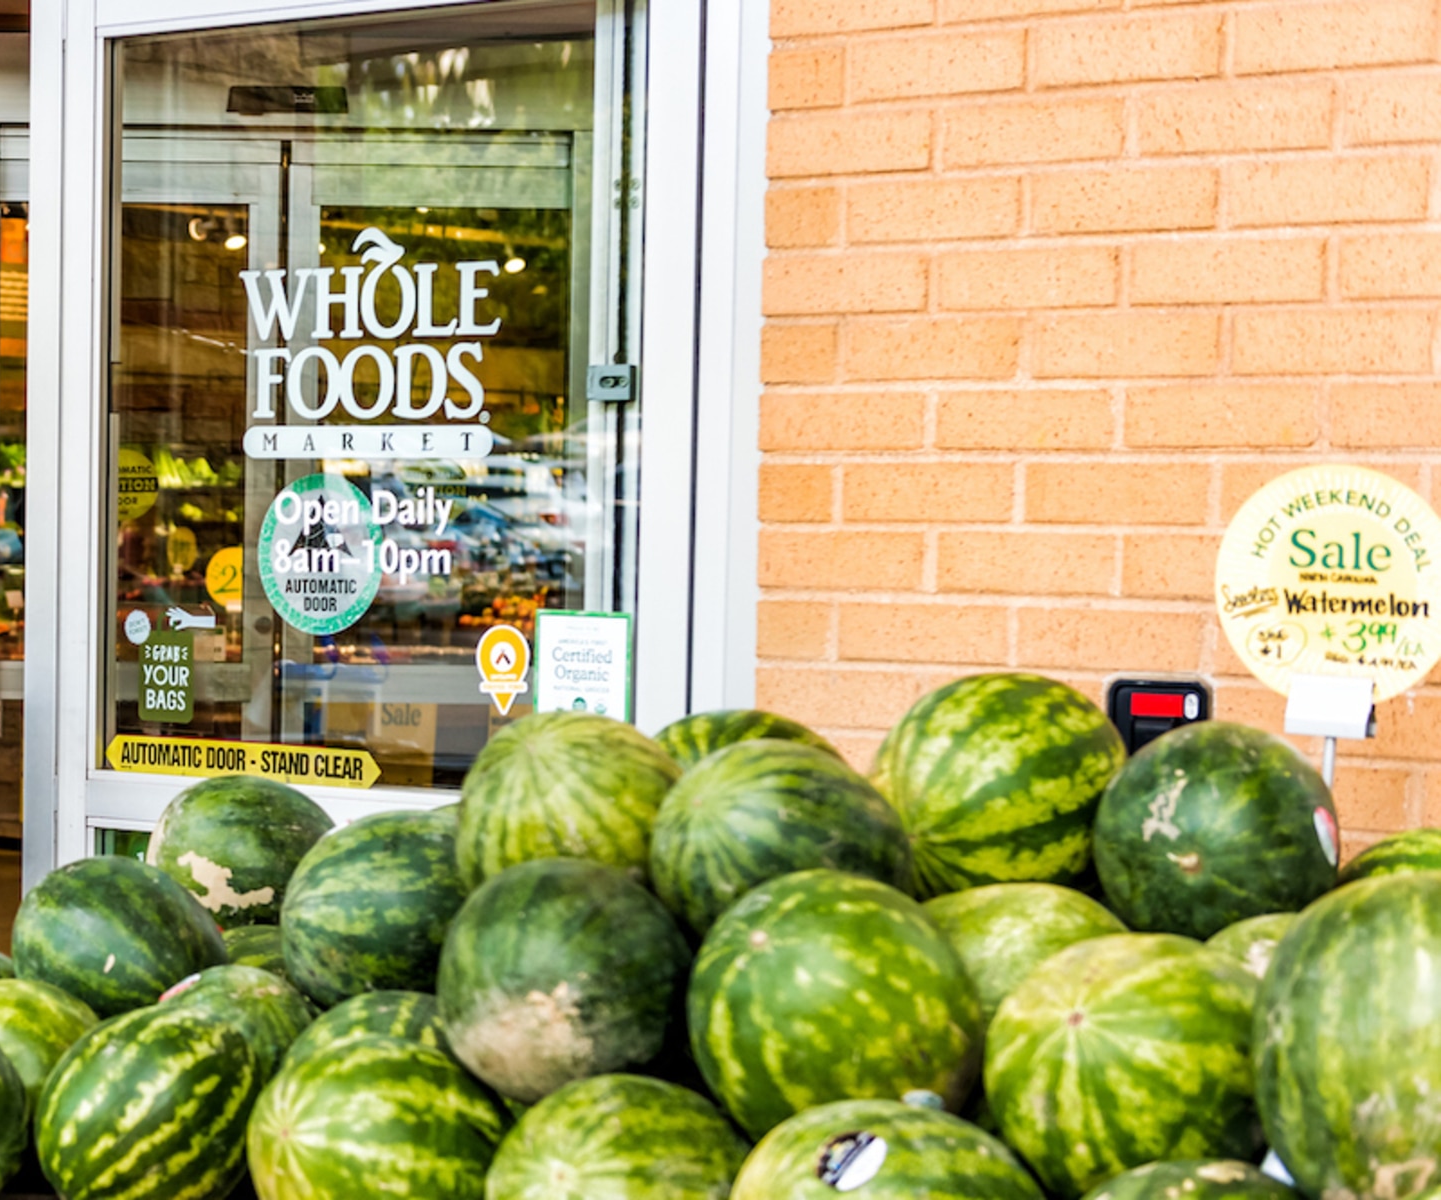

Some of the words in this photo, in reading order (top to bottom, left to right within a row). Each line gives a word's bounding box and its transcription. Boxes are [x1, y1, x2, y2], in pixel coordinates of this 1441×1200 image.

[239, 227, 501, 341] WHOLE
[252, 342, 485, 420] FOODS
[262, 432, 474, 452] MARKET
[274, 490, 358, 536] Open
[371, 486, 453, 536] Daily
[1250, 514, 1281, 559] HOT
[1280, 489, 1391, 518] WEEKEND
[1393, 517, 1432, 573] DEAL
[1288, 528, 1391, 572] Sale
[285, 578, 357, 595] AUTOMATIC
[303, 597, 338, 612] DOOR
[1283, 588, 1430, 618] Watermelon
[152, 644, 181, 662] GRAB
[552, 646, 613, 664] Certified
[143, 664, 190, 687] YOUR
[554, 664, 610, 683] Organic
[145, 688, 186, 711] BAGS
[381, 703, 422, 727] Sale
[121, 741, 202, 768] AUTOMATIC
[206, 746, 246, 772] DOOR
[260, 750, 309, 776] STAND
[314, 754, 364, 781] CLEAR
